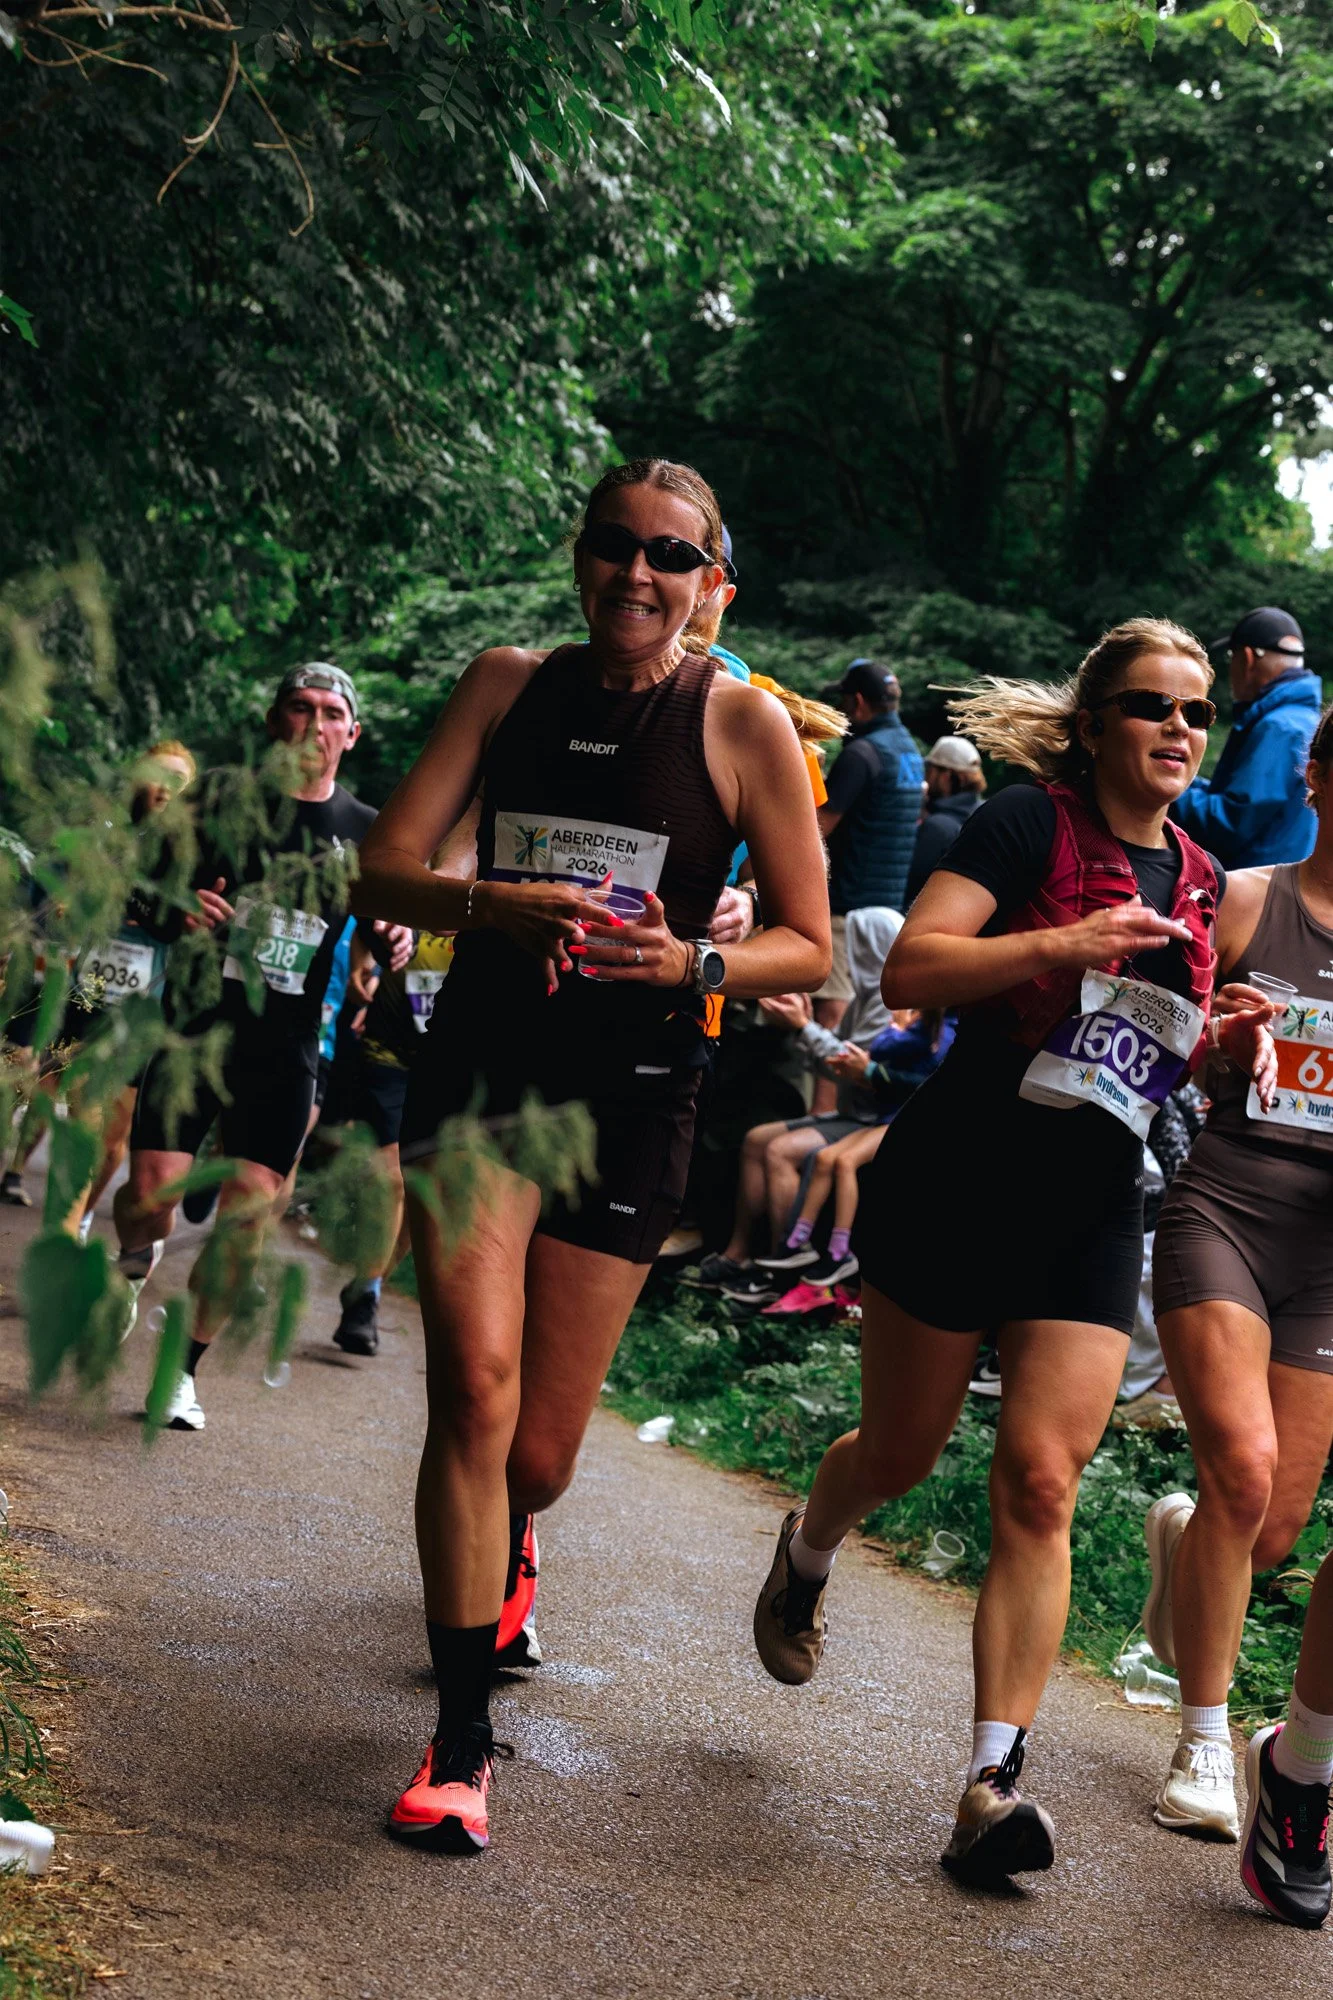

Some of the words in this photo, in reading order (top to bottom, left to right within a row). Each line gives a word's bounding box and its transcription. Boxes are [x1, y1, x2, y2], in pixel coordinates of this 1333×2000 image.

[569, 739, 619, 755] BANDIT
[551, 829, 638, 855] ABERDEEN
[550, 844, 575, 855] HALF
[576, 847, 635, 866] MARATHON
[566, 857, 608, 875] 2026
[1131, 986, 1191, 1025] ABERDEEN
[1131, 1008, 1164, 1035] 2026
[1070, 1014, 1159, 1086] 1503
[609, 1201, 637, 1215] BANDIT
